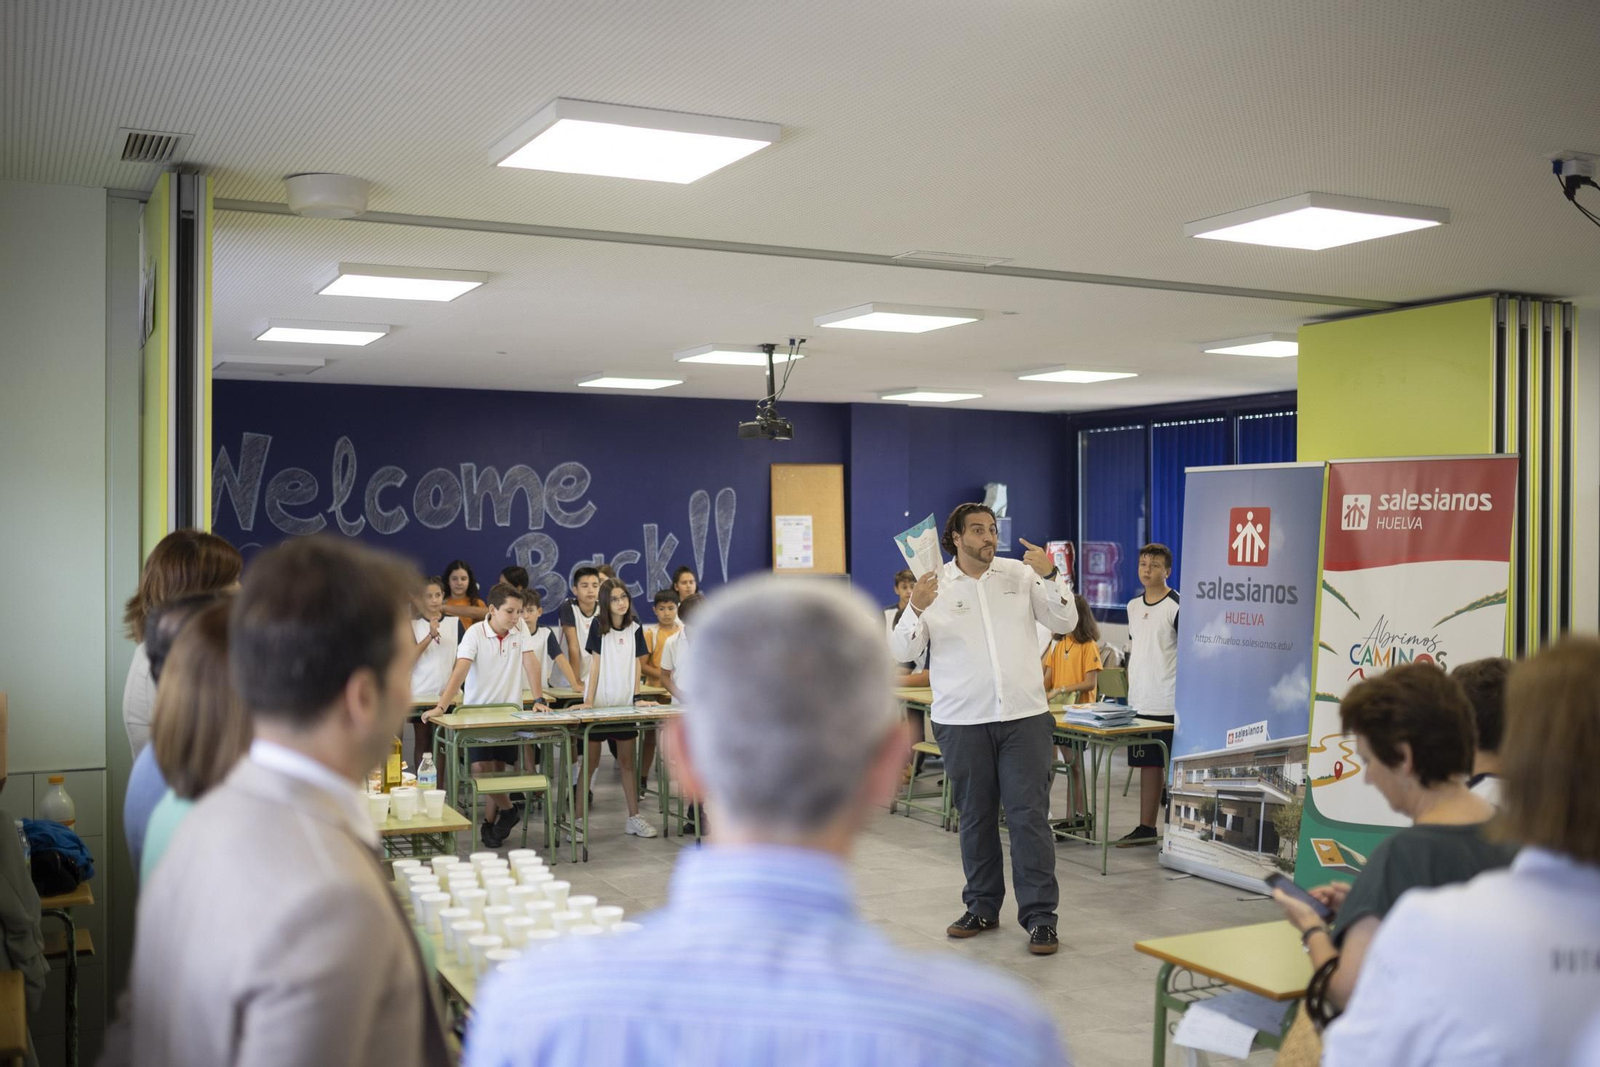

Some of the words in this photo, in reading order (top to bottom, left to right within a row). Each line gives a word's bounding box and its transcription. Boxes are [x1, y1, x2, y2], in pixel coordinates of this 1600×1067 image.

[212, 432, 597, 536] Welcome
[1377, 488, 1493, 512] salesianos
[1376, 516, 1423, 530] HUELVA
[1196, 576, 1299, 605] salesianos
[1225, 611, 1265, 627] HUELVA
[1358, 613, 1443, 655] Abrimos
